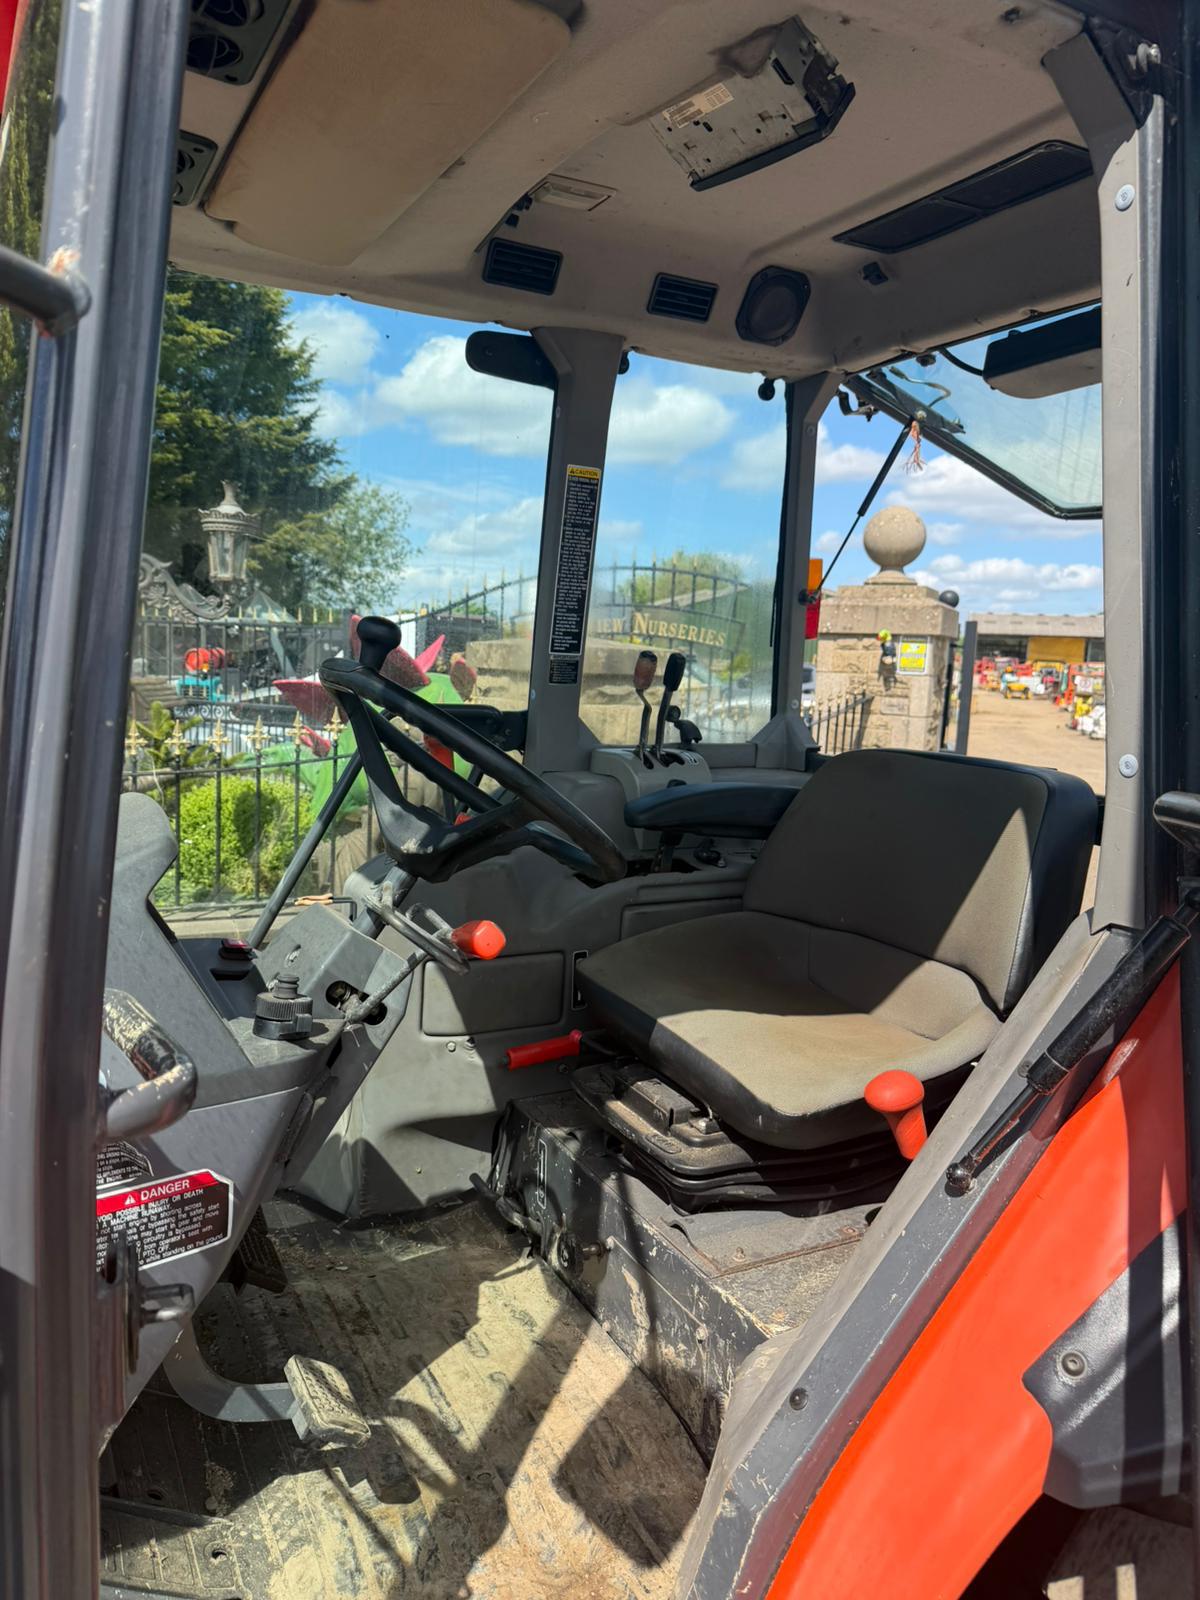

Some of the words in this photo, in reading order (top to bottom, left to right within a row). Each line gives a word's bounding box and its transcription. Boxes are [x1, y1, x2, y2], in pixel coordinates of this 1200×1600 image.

[575, 469, 598, 477] CAUTION
[632, 611, 727, 647] NURSERIES
[141, 1179, 190, 1201] DANGER
[97, 1213, 113, 1222] VOID
[116, 1204, 145, 1216] POSSIBLE
[147, 1197, 169, 1208] INJURY
[172, 1195, 181, 1203] OR
[183, 1189, 204, 1199] DEATH
[129, 1217, 148, 1228] engine
[160, 1207, 181, 1218] shorting
[184, 1202, 202, 1211] across
[148, 1216, 176, 1229] bypassing
[178, 1212, 187, 1220] the
[189, 1207, 206, 1217] safety
[208, 1203, 220, 1211] start
[110, 1212, 138, 1226] MACHINE
[140, 1229, 153, 1238] may
[155, 1225, 168, 1233] start
[178, 1219, 190, 1228] gear
[192, 1215, 203, 1223] and
[204, 1210, 219, 1219] move
[143, 1242, 157, 1250] from
[159, 1233, 186, 1246] operator's
[188, 1229, 199, 1238] seat
[202, 1225, 213, 1233] with
[143, 1233, 166, 1245] circuitry
[142, 1248, 156, 1258] PTO
[146, 1254, 161, 1263] while
[162, 1246, 186, 1259] standing
[195, 1239, 204, 1247] the
